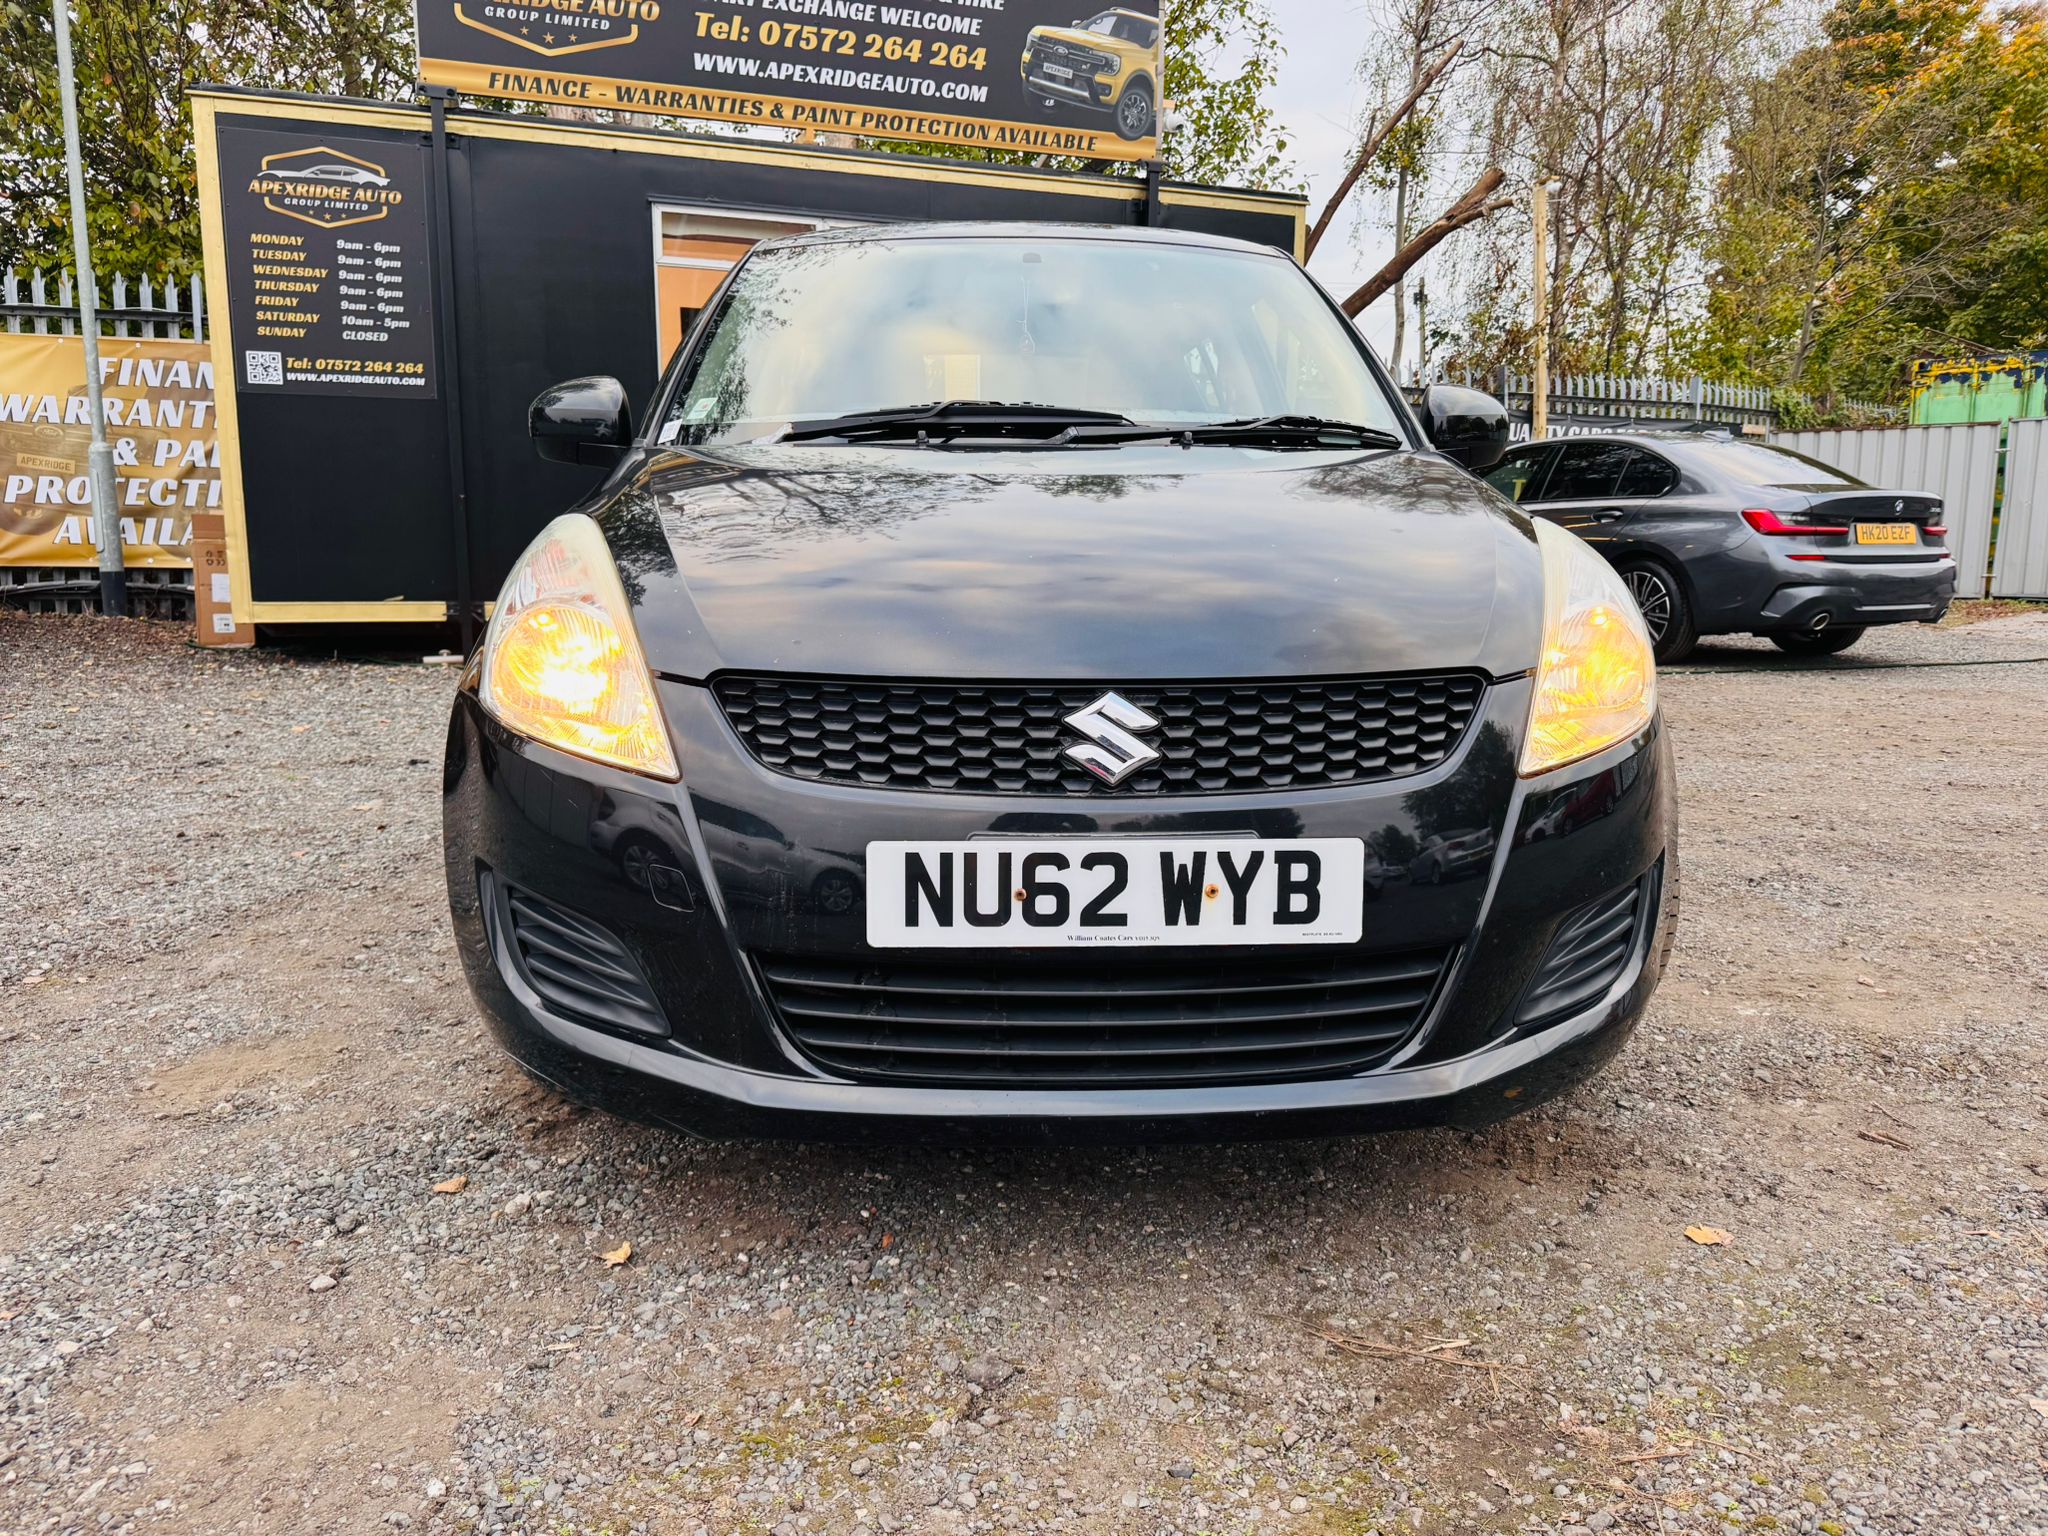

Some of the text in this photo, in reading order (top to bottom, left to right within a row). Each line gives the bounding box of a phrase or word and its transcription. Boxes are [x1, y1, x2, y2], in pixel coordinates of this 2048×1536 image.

[484, 6, 611, 30] GROUP LIMITED
[588, 0, 661, 21] AUTO
[762, 0, 983, 36] EXCHANGE WELCOME
[694, 12, 987, 71] Tel: 07572 264 264
[693, 52, 988, 103] WWW.APEXRIDGEAUTO.COM
[488, 72, 593, 99] FINANCE
[615, 85, 764, 117] WARRANTIES
[770, 103, 785, 119] &
[792, 105, 857, 127] PAINT
[860, 112, 991, 141] PROTECTION
[995, 126, 1098, 152] AVAILABLE
[248, 179, 402, 205] APEXRIDGE AUTO
[284, 197, 369, 211] GROUP LIMITED
[250, 233, 305, 246] MONDAY
[336, 239, 363, 251] 9am
[374, 242, 401, 254] 6pm
[252, 249, 307, 262] TUESDAY
[337, 255, 364, 266] 9am
[374, 257, 402, 269] 6pm
[253, 264, 329, 279] WEDNESDAY
[338, 270, 365, 281] 9am
[375, 272, 403, 284] 6pm
[254, 280, 320, 293] THURSDAY
[339, 285, 366, 296] 9am
[376, 288, 403, 299] 6pm
[255, 295, 300, 307] FRIDAY
[340, 300, 367, 311] 9am
[377, 302, 404, 314] 6pm
[256, 310, 321, 324] SATURDAY
[341, 315, 374, 326] 10am
[384, 318, 410, 330] 5pm
[257, 326, 389, 342] SUNDAY CLOSED
[286, 357, 424, 374] Tel: 07572 264 264
[286, 372, 426, 386] WWW.APEXRIDGEAUTO.COM
[0, 393, 218, 429] WARRANT
[113, 437, 140, 466] &
[21, 456, 71, 471] APEXRIDGE
[4, 475, 221, 507] PROECTI
[1861, 525, 1910, 540] HK20 EZF
[905, 850, 1322, 927] NU62 WYB
